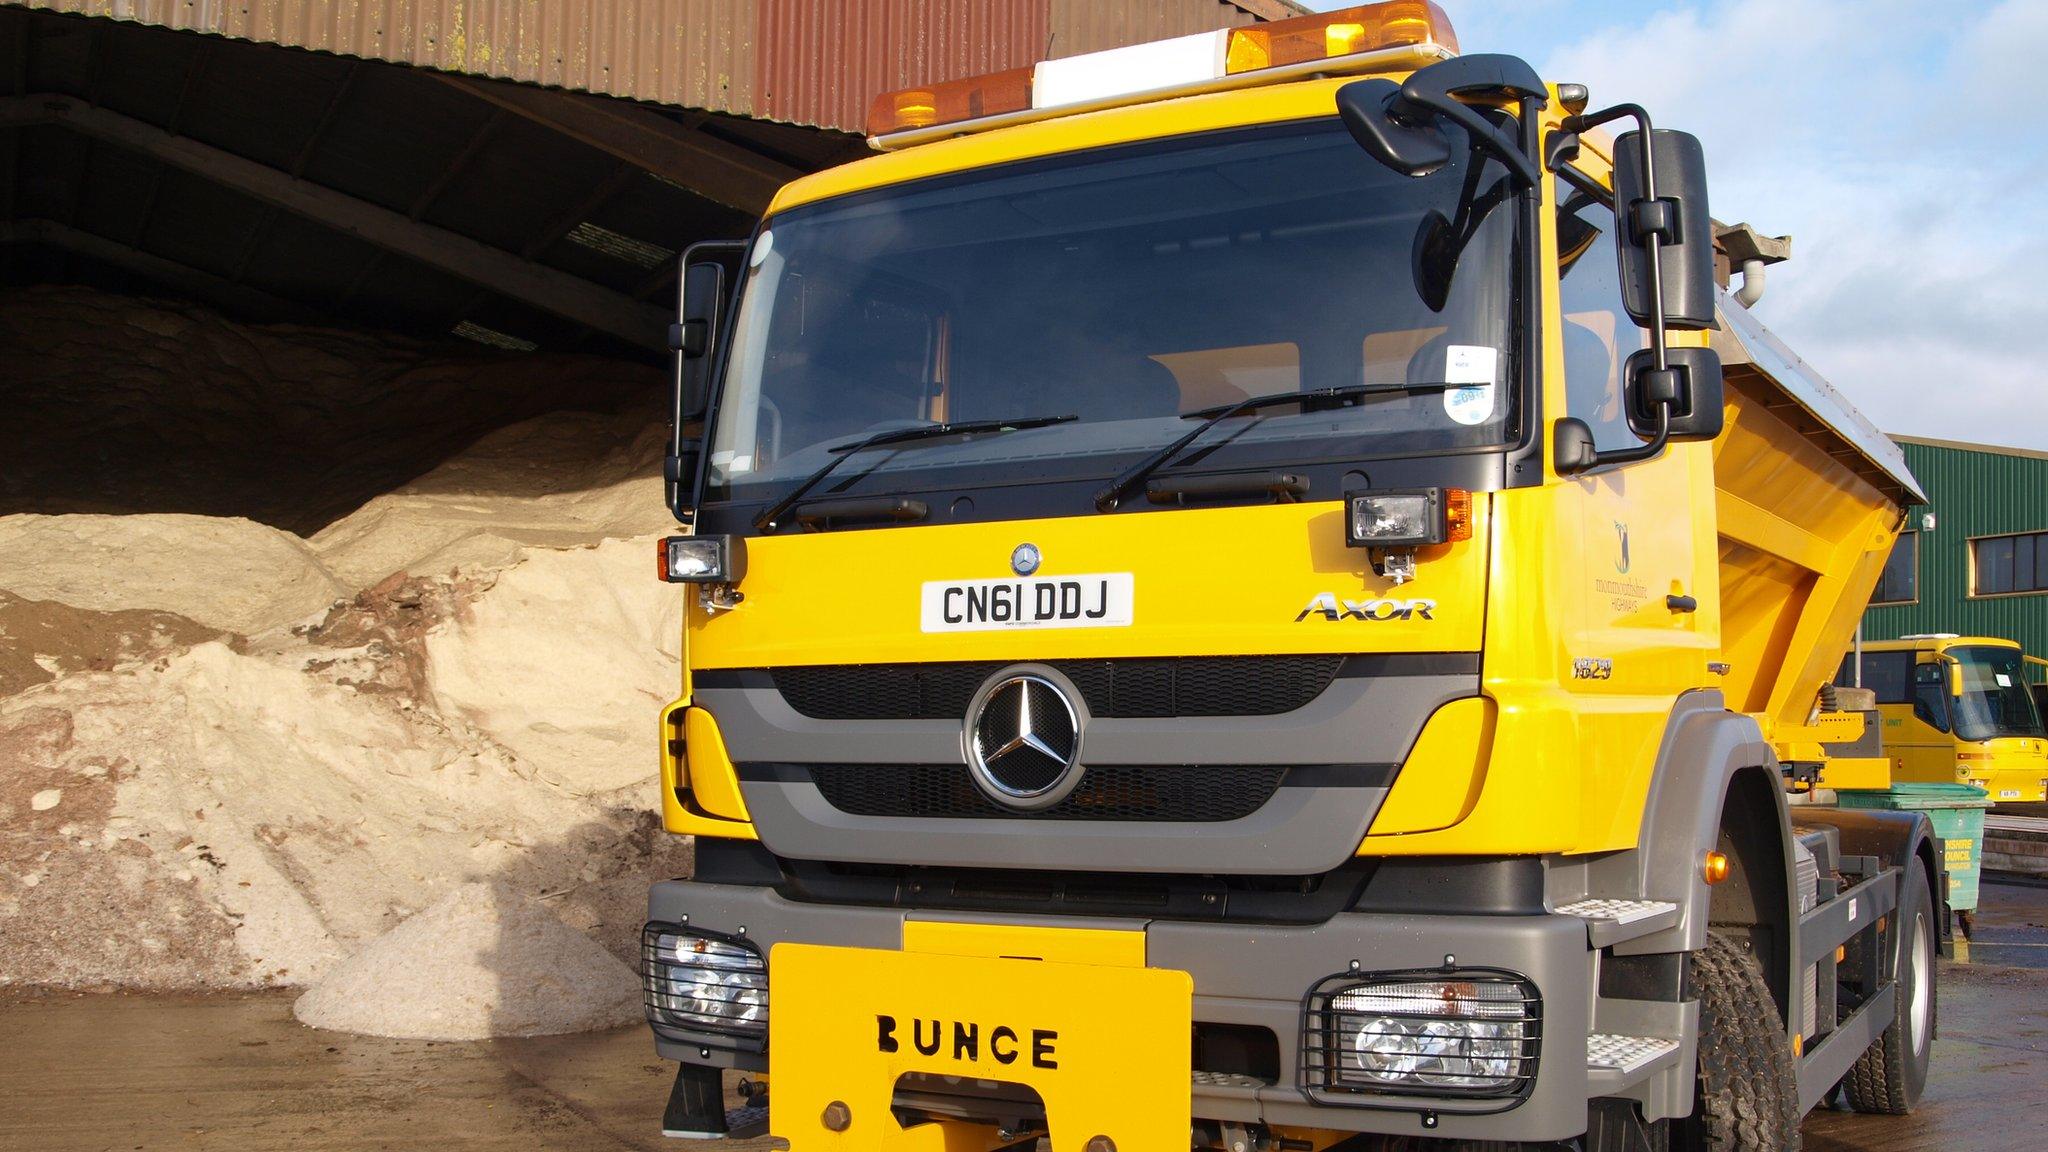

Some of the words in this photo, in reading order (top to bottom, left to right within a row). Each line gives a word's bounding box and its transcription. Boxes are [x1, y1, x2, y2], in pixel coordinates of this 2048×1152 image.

[943, 584, 1022, 624] CN61
[1035, 580, 1108, 620] DDJ
[1294, 592, 1437, 622] AXOR
[1945, 850, 1971, 862] OUNCIL
[875, 1014, 1058, 1070] BUNCE
